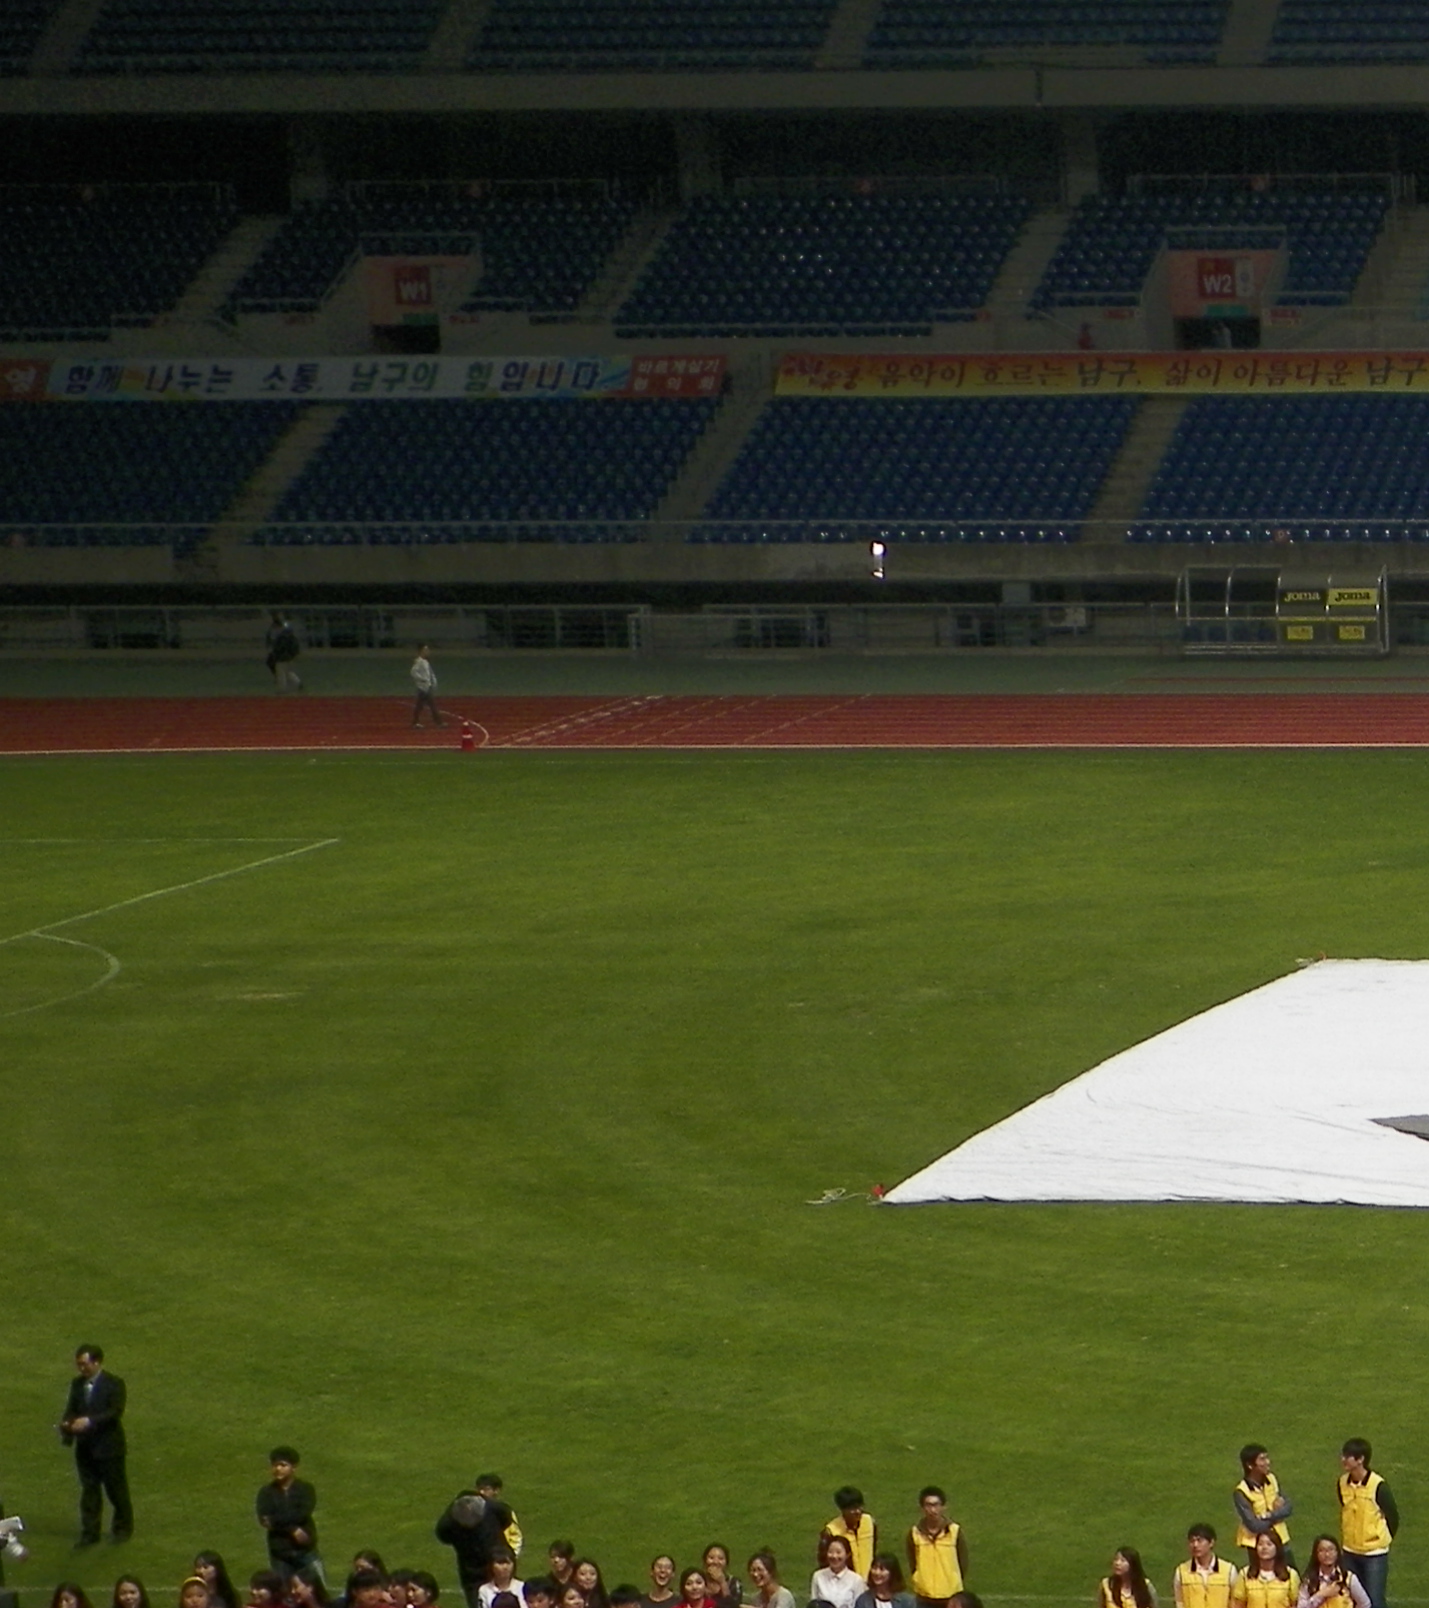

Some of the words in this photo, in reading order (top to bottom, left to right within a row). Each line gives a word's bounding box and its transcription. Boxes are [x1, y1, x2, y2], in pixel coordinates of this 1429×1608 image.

[1203, 274, 1233, 294] W2
[65, 364, 123, 395] 함께
[145, 363, 234, 393] 나누는
[349, 359, 439, 394] 남구의
[878, 361, 964, 388] 음악이
[973, 361, 1066, 387] 흐르는
[1164, 357, 1222, 387] 삶이
[1232, 357, 1352, 387] 아름다운
[1365, 356, 1428, 386] 남구
